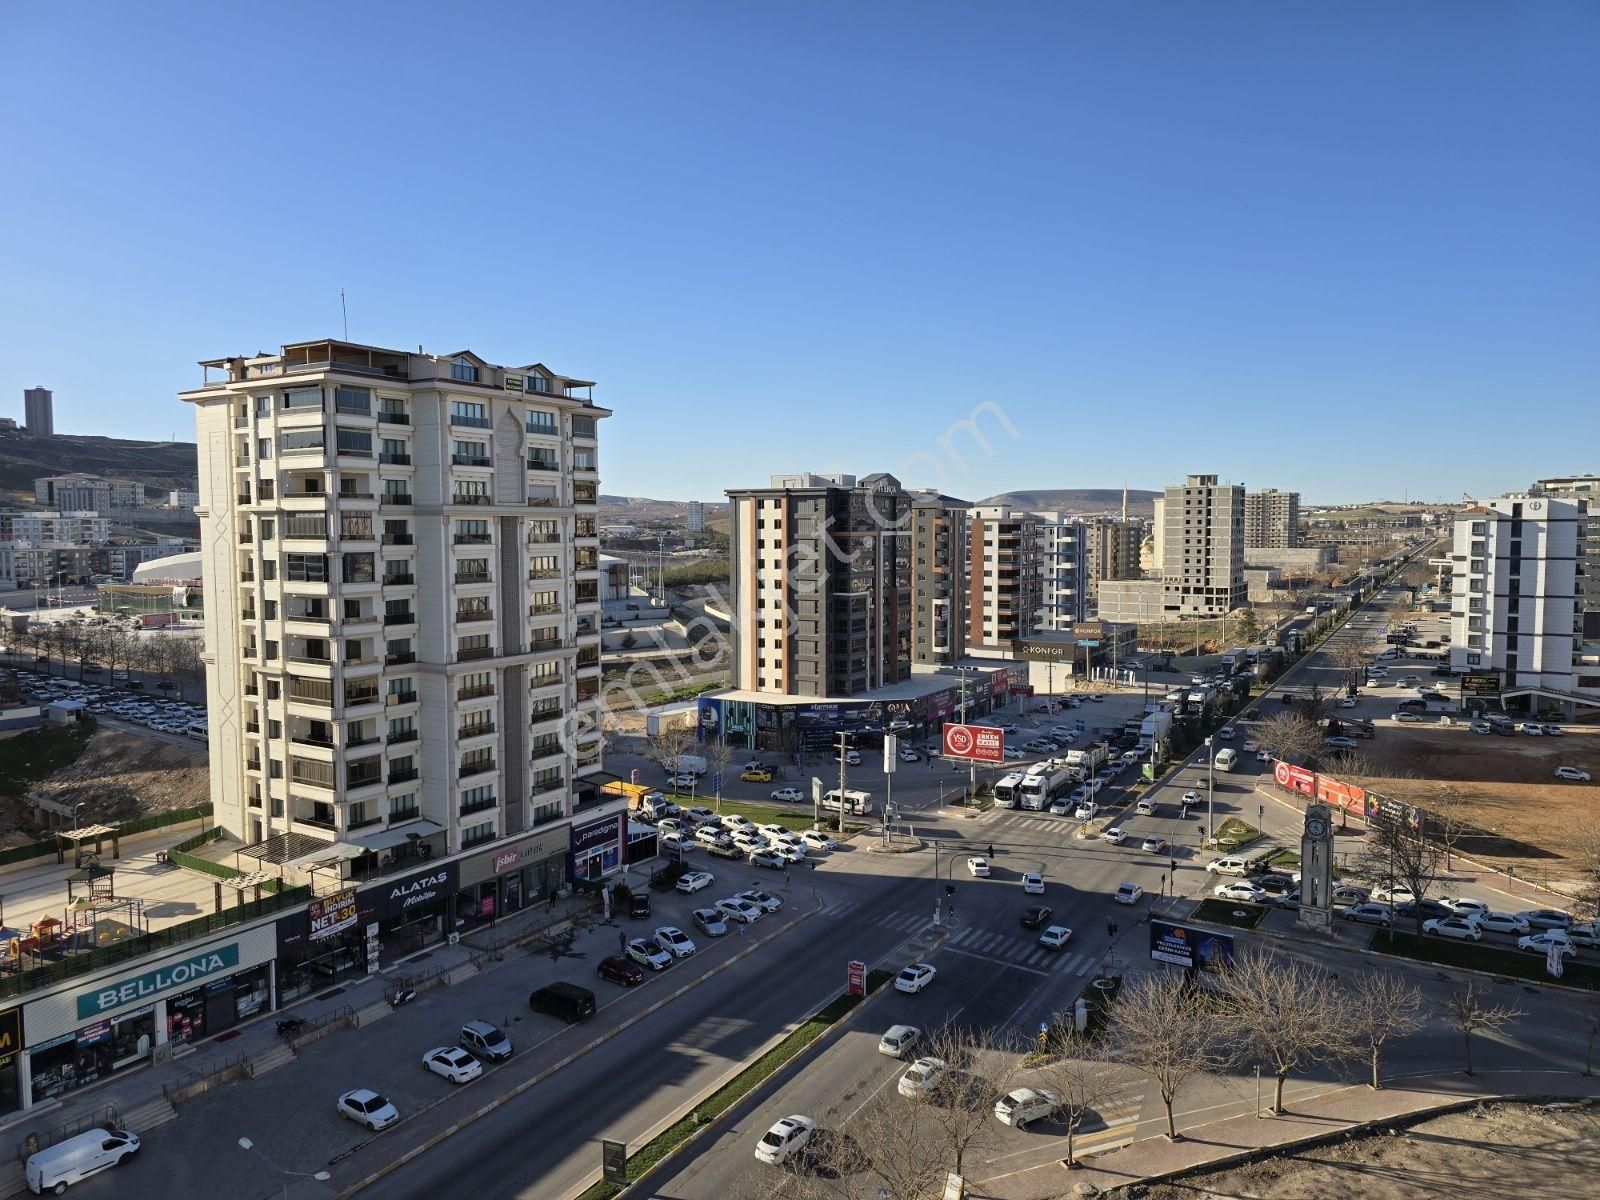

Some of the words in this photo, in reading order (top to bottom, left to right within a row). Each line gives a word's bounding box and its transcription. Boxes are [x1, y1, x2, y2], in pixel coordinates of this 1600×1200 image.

[1030, 646, 1064, 655] KONFOR
[953, 733, 967, 743] YSD
[582, 822, 618, 841] paradigma
[311, 912, 337, 932] NET
[97, 953, 224, 1009] BELLONA
